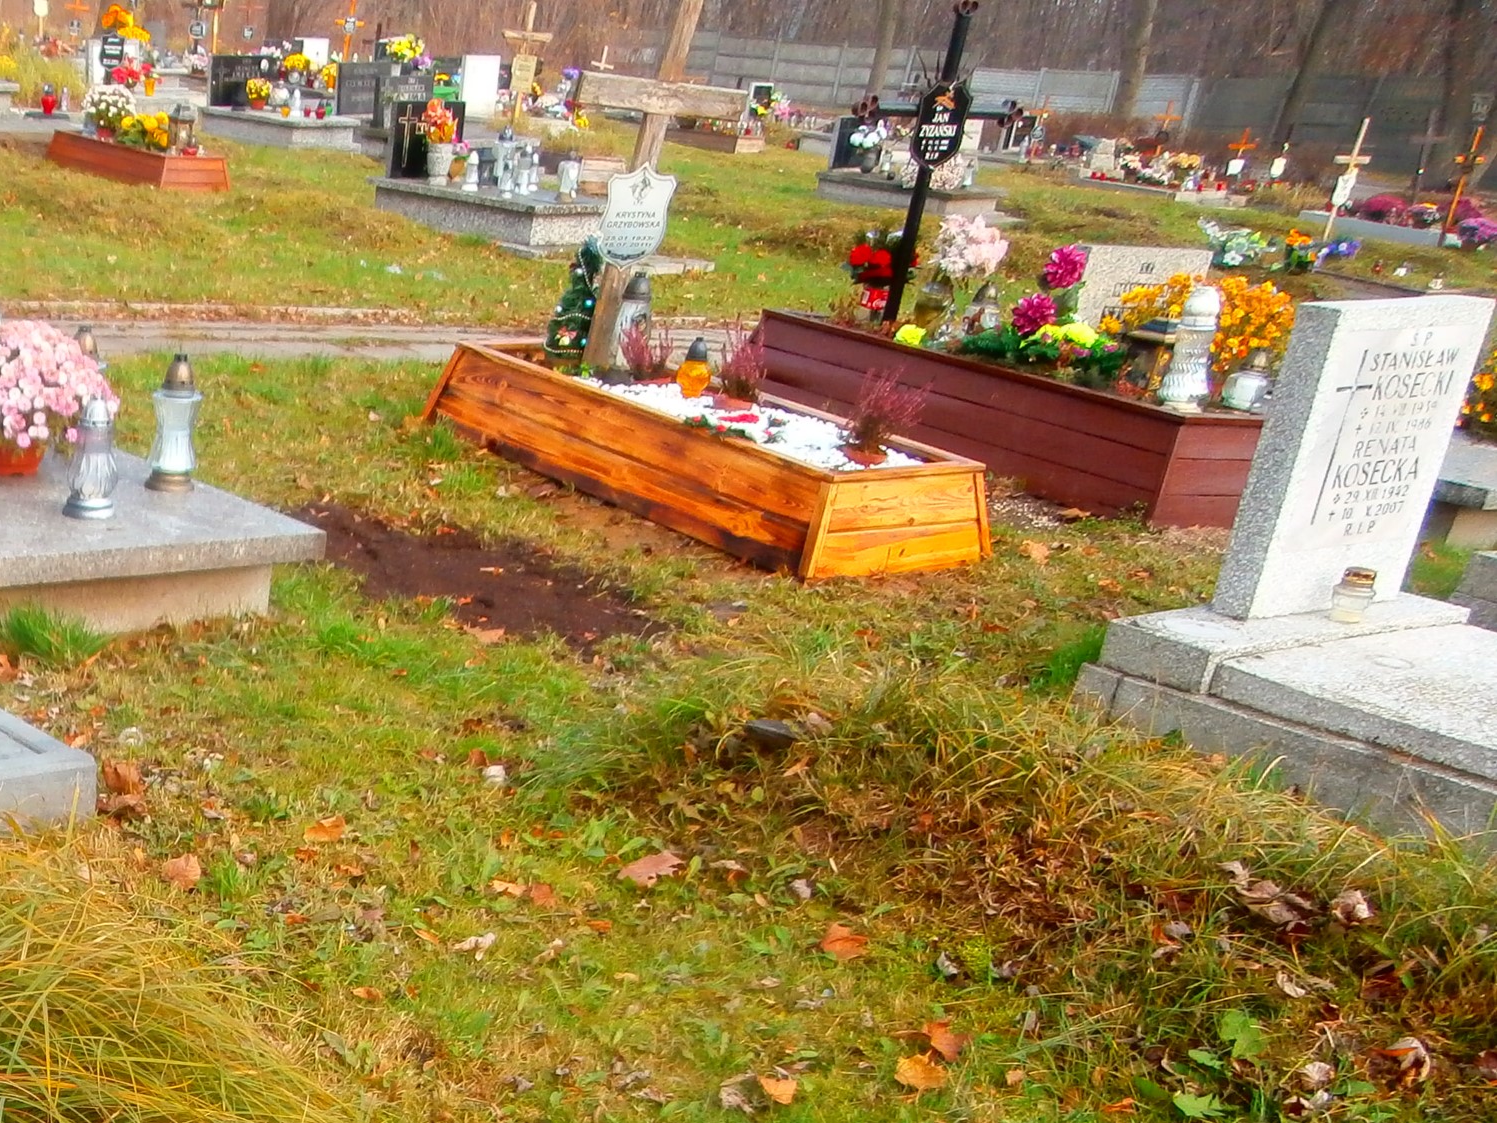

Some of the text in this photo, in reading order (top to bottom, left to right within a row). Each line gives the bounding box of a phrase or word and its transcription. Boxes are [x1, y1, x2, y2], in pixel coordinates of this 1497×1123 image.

[932, 112, 950, 123] JAN
[606, 220, 660, 229] GRZYBOWSKA
[615, 211, 656, 219] KRYSTYNA
[1370, 347, 1460, 372] STANISŁAW
[1372, 370, 1454, 400] KOSECKI
[1353, 435, 1417, 459] RENATA
[1331, 456, 1420, 489] KOSECKA
